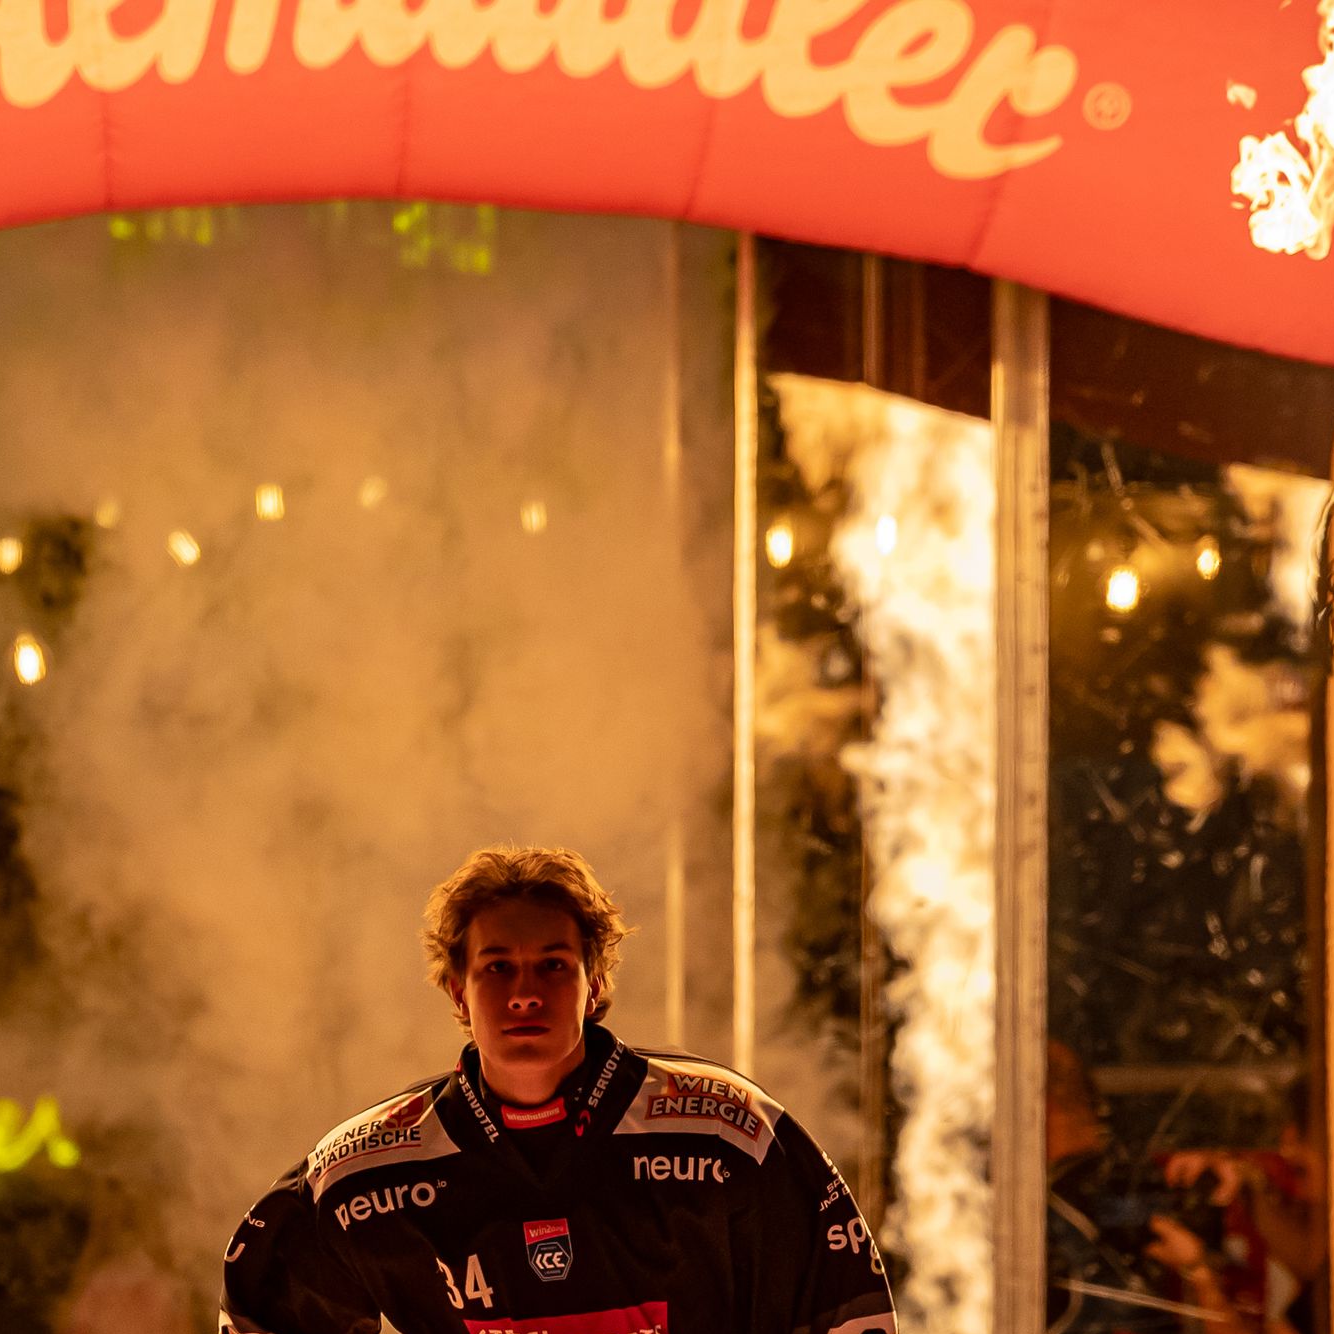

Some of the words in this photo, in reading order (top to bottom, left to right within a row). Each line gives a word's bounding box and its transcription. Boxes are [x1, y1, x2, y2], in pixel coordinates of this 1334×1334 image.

[458, 1073, 500, 1143] SERVOTEL
[673, 1074, 748, 1105] WIEN
[650, 1097, 759, 1136] ENERGIE
[315, 1119, 383, 1160] WIENER
[535, 1251, 565, 1269] ICE
[436, 1253, 494, 1310] 34
